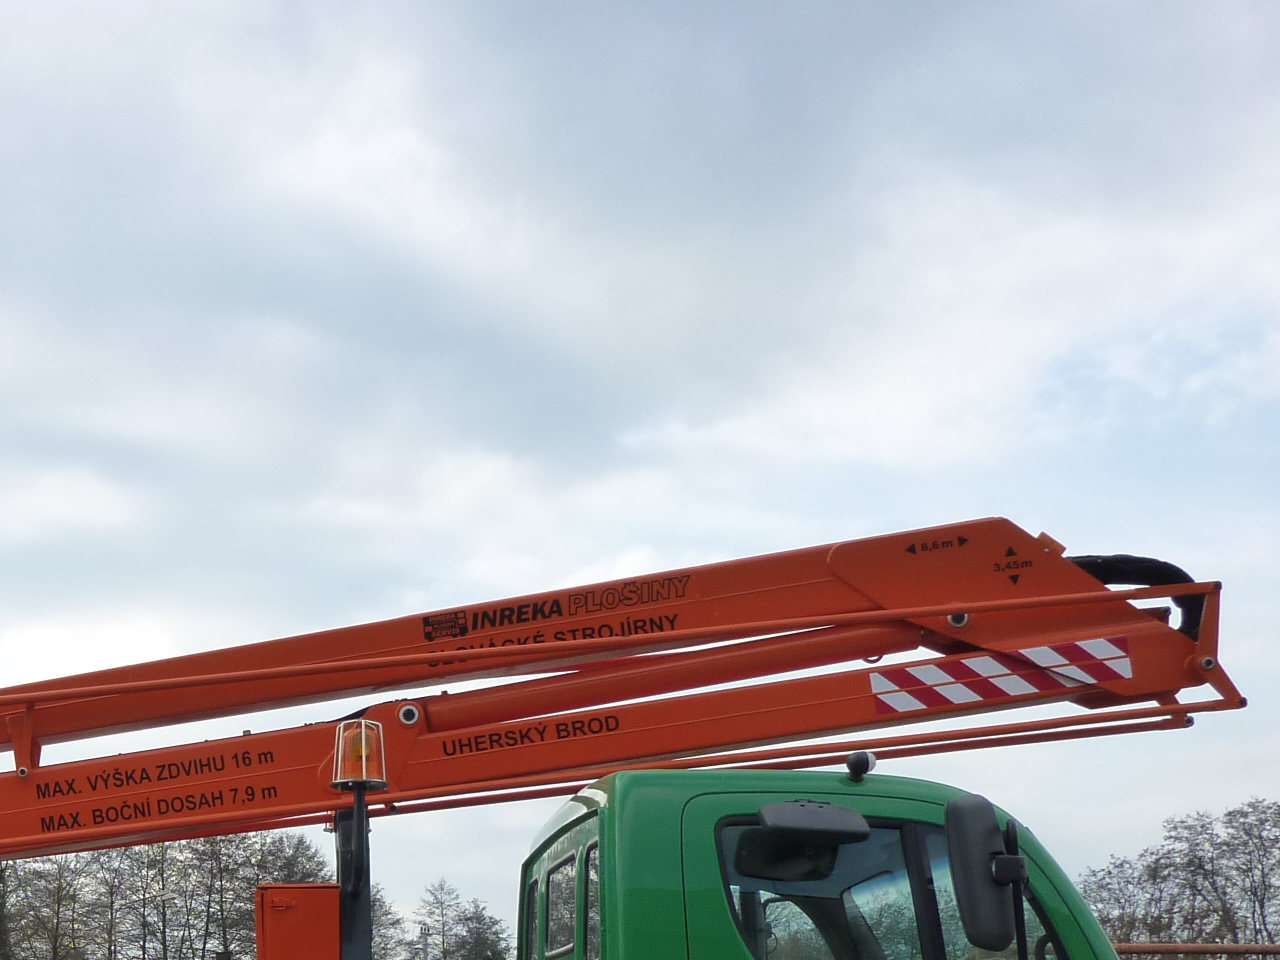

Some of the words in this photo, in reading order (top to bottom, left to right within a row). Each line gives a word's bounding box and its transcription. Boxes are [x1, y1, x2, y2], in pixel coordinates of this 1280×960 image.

[472, 599, 563, 631] INREKA
[569, 575, 691, 616] PLOŠINY
[442, 722, 548, 757] UHERSKÝ
[555, 715, 620, 739] BROD
[36, 779, 82, 799] MAX.
[87, 770, 152, 792] VÝŠKA
[156, 755, 225, 782] ZDVIHU
[232, 752, 252, 769] 16
[258, 750, 274, 764] m
[40, 812, 86, 833] MAX.
[92, 797, 152, 825] BOČNÍ
[157, 791, 224, 816] DOSAH
[229, 786, 255, 805] 7,9
[261, 785, 277, 799] m
